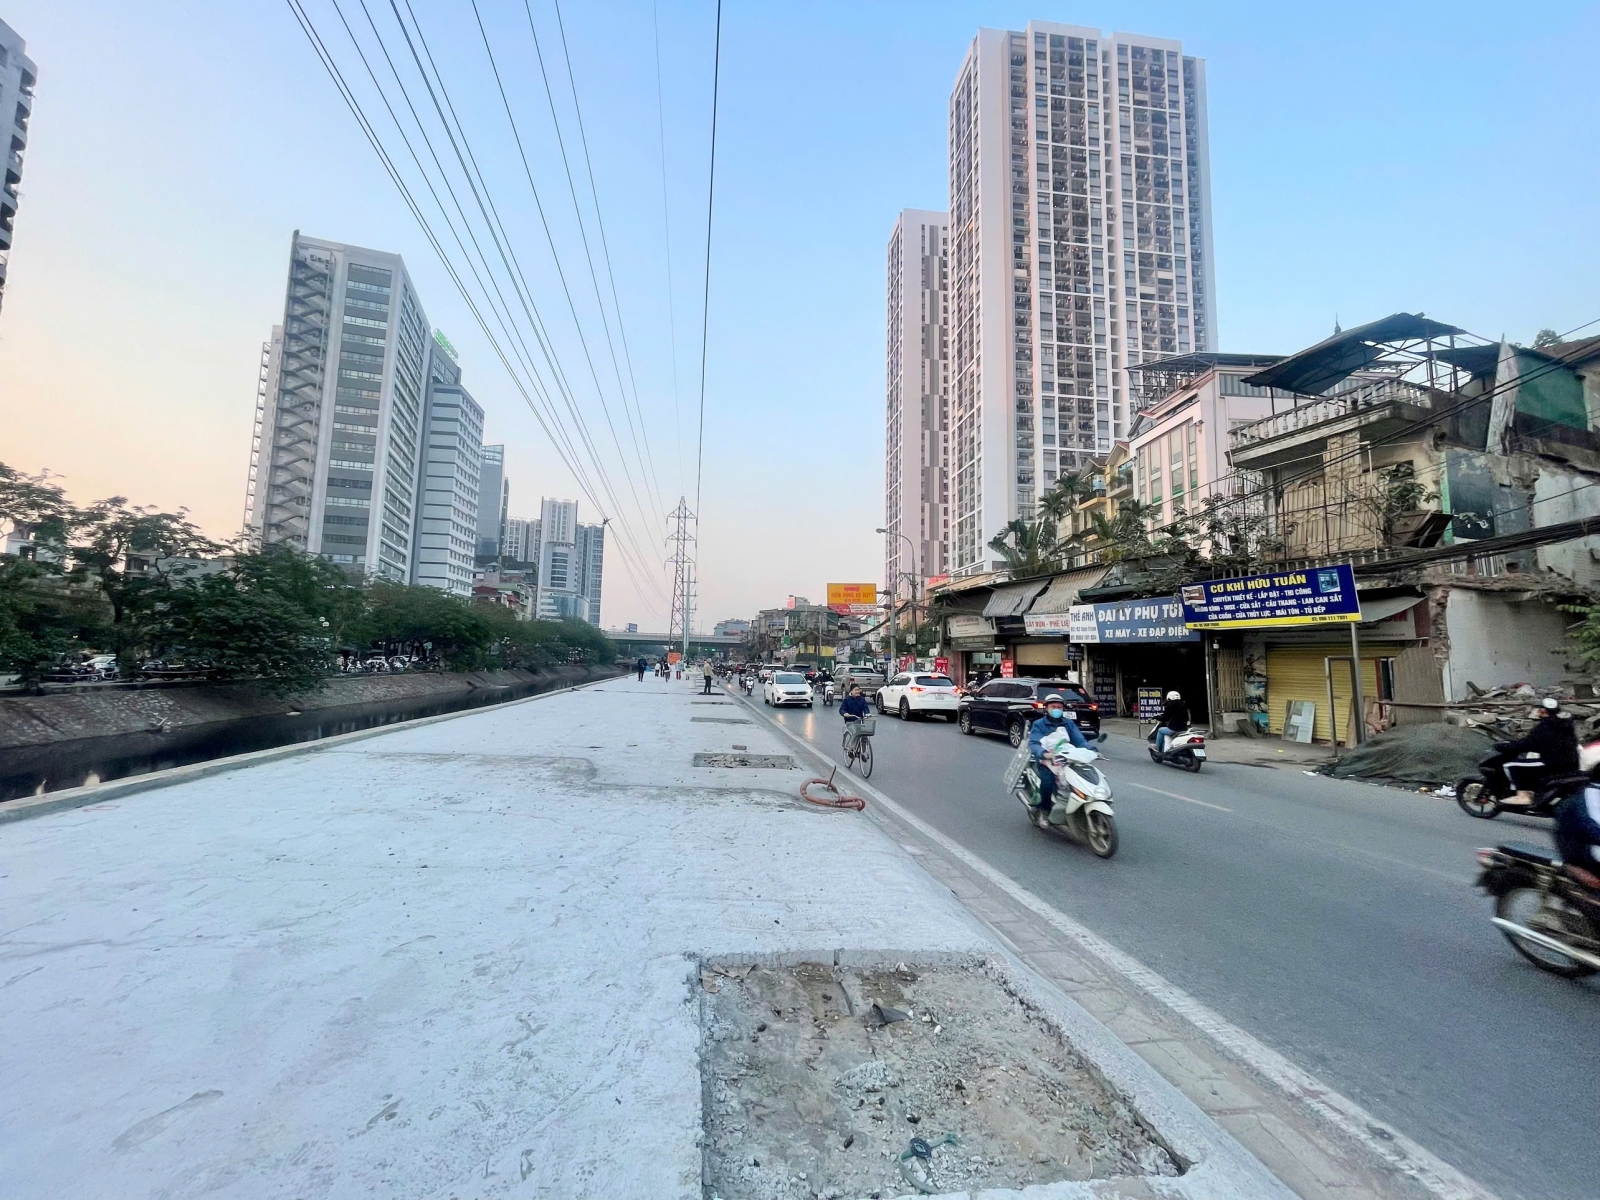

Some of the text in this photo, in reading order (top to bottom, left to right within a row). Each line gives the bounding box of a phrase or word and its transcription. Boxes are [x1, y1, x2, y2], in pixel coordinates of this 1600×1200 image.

[1210, 572, 1306, 593] CƠ KHÍ HỮU TUẤN
[1330, 593, 1342, 602] SẮT
[1098, 609, 1116, 624] ĐẠI
[1120, 605, 1132, 620] LÝ
[1135, 605, 1158, 622] PHỤ
[1105, 630, 1113, 638] XE
[1115, 627, 1131, 638] MÁY
[1138, 628, 1147, 637] XE
[1149, 628, 1166, 639] ĐẠP
[1168, 625, 1189, 638] ĐIỆN
